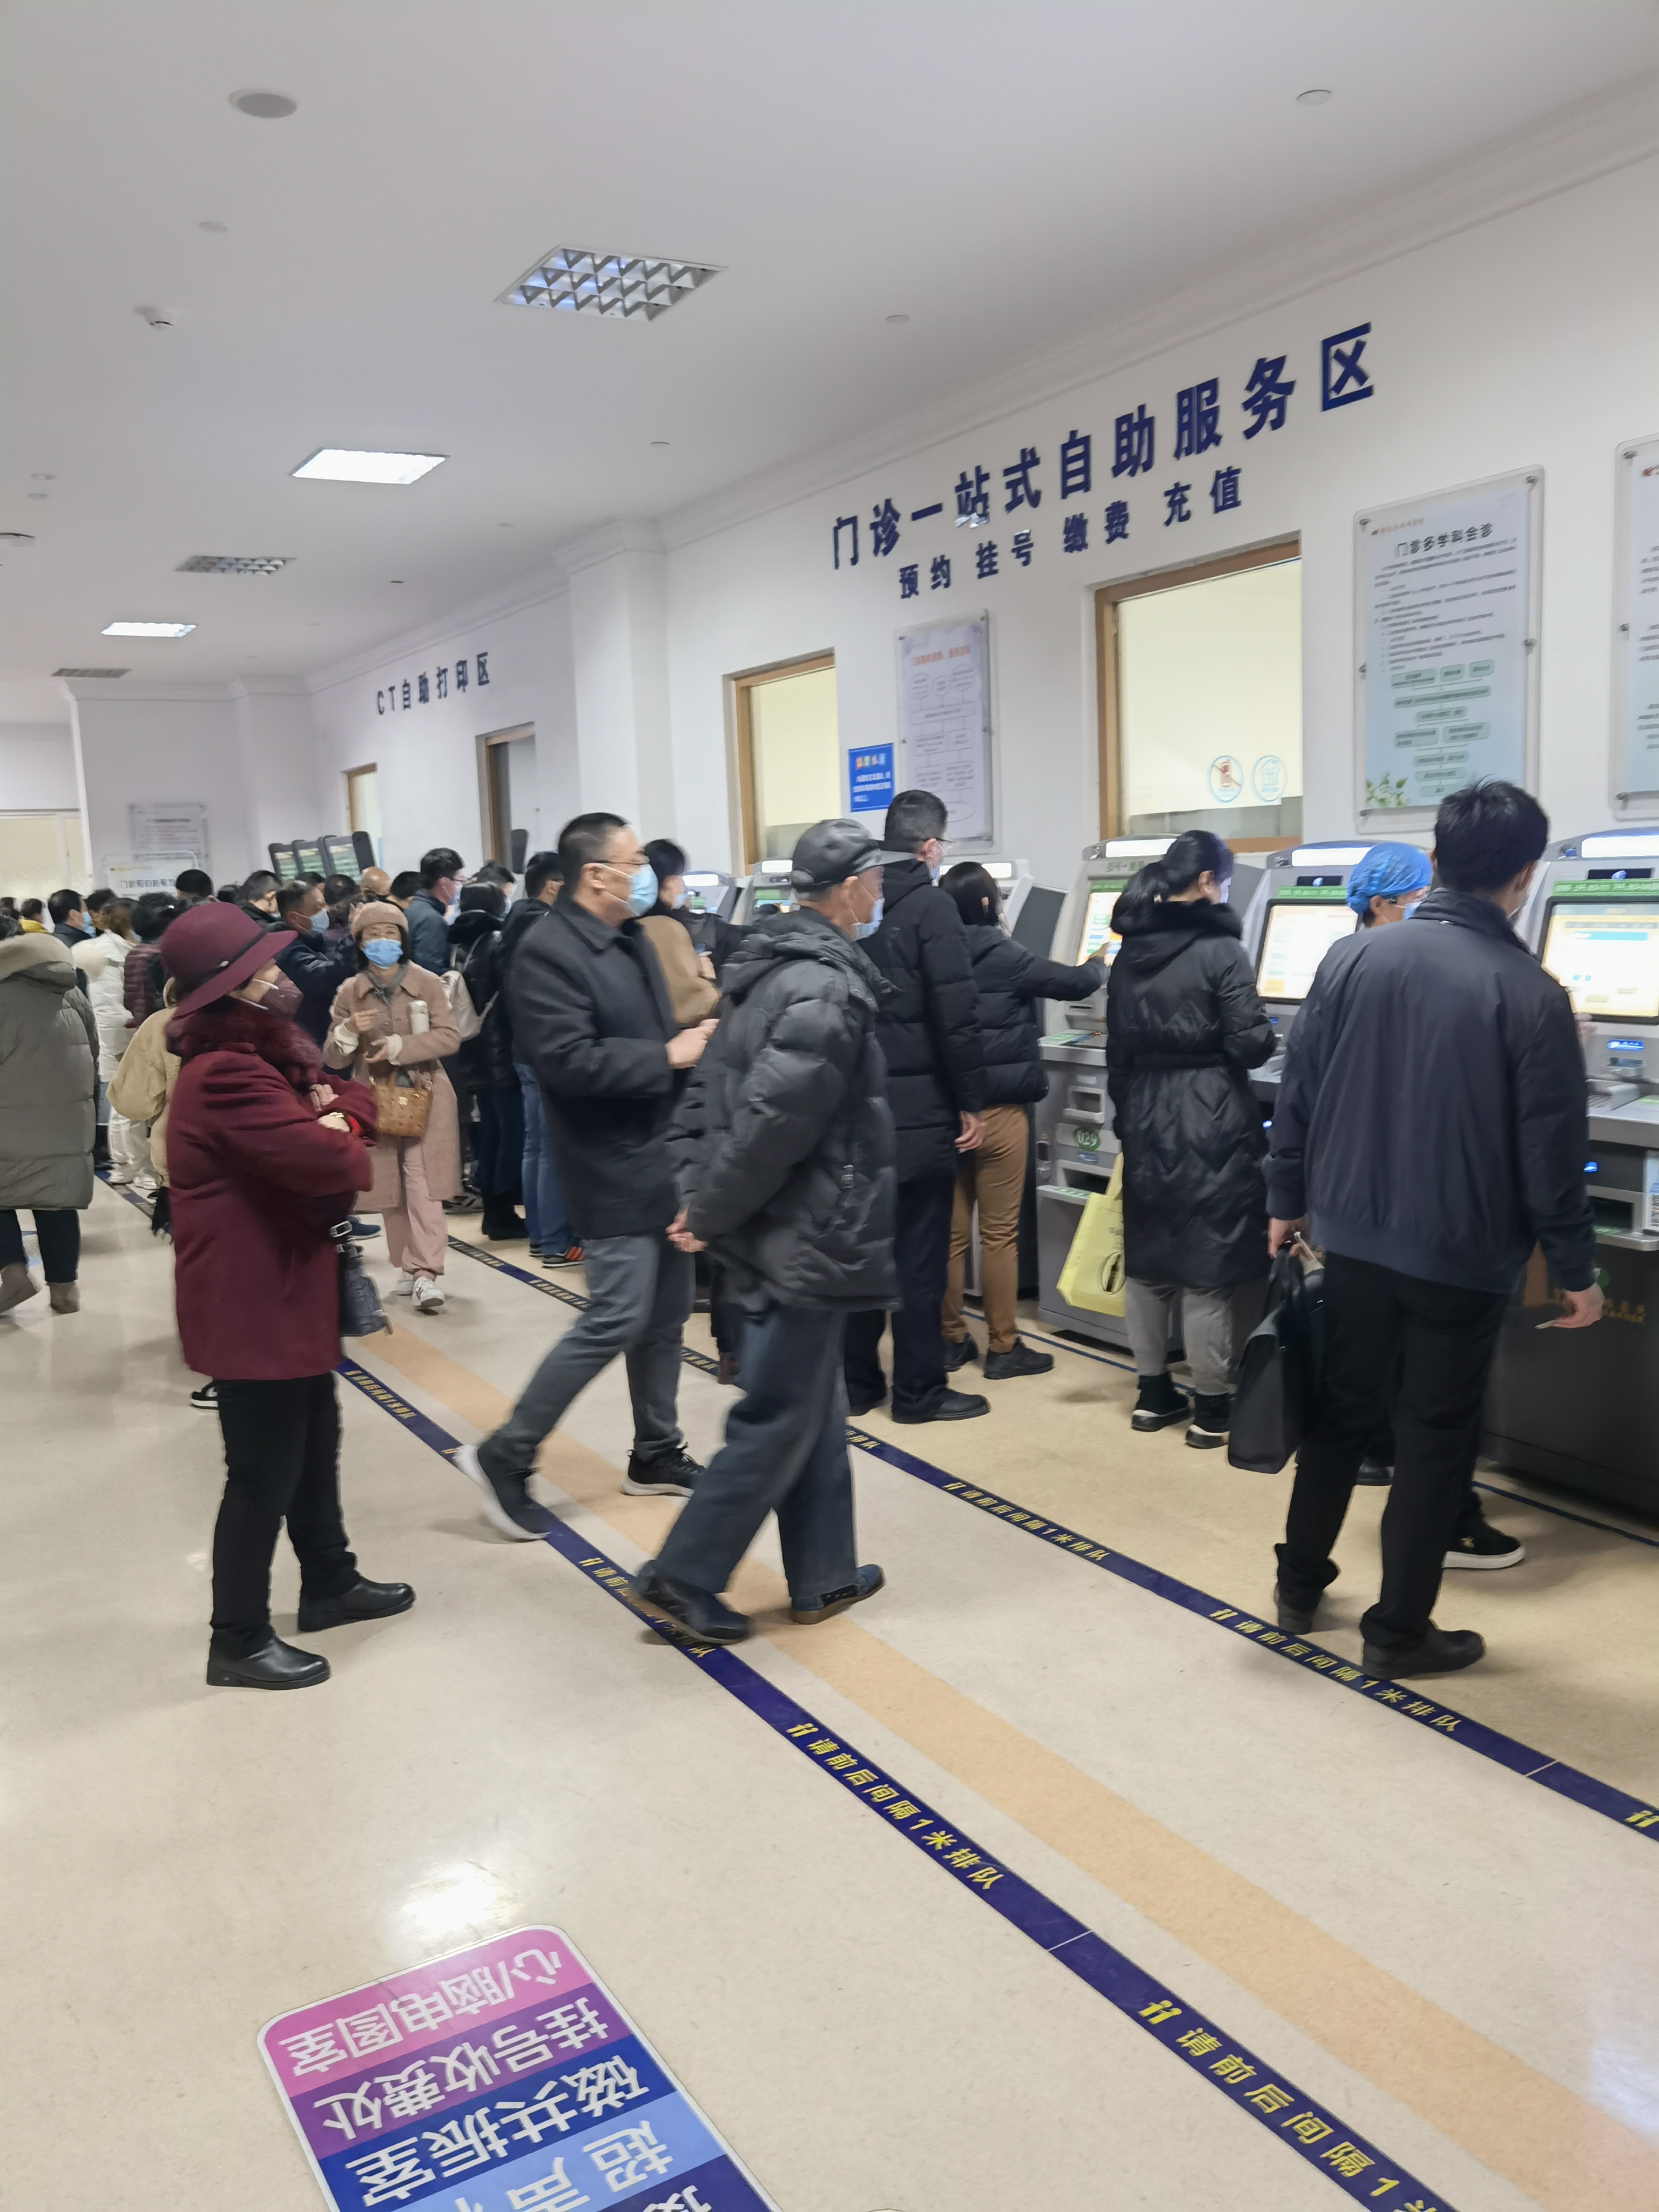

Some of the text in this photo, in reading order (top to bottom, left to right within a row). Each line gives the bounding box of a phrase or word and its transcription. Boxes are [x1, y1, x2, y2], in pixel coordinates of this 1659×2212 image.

[832, 322, 1374, 569] 门诊一站式自助服务区
[899, 466, 1242, 599] 预约 挂号 缴费 充值
[377, 652, 490, 715] CT自助打印区
[1235, 1620, 1462, 1731] 请前后间隔1米排队
[806, 1738, 1004, 1890] 请前后间隔1米排队
[278, 1949, 562, 2076] 心/脑电图室
[313, 1997, 609, 2140] 挂号收费处
[345, 2055, 649, 2207] 磁共振室
[454, 2120, 673, 2212] 超声
